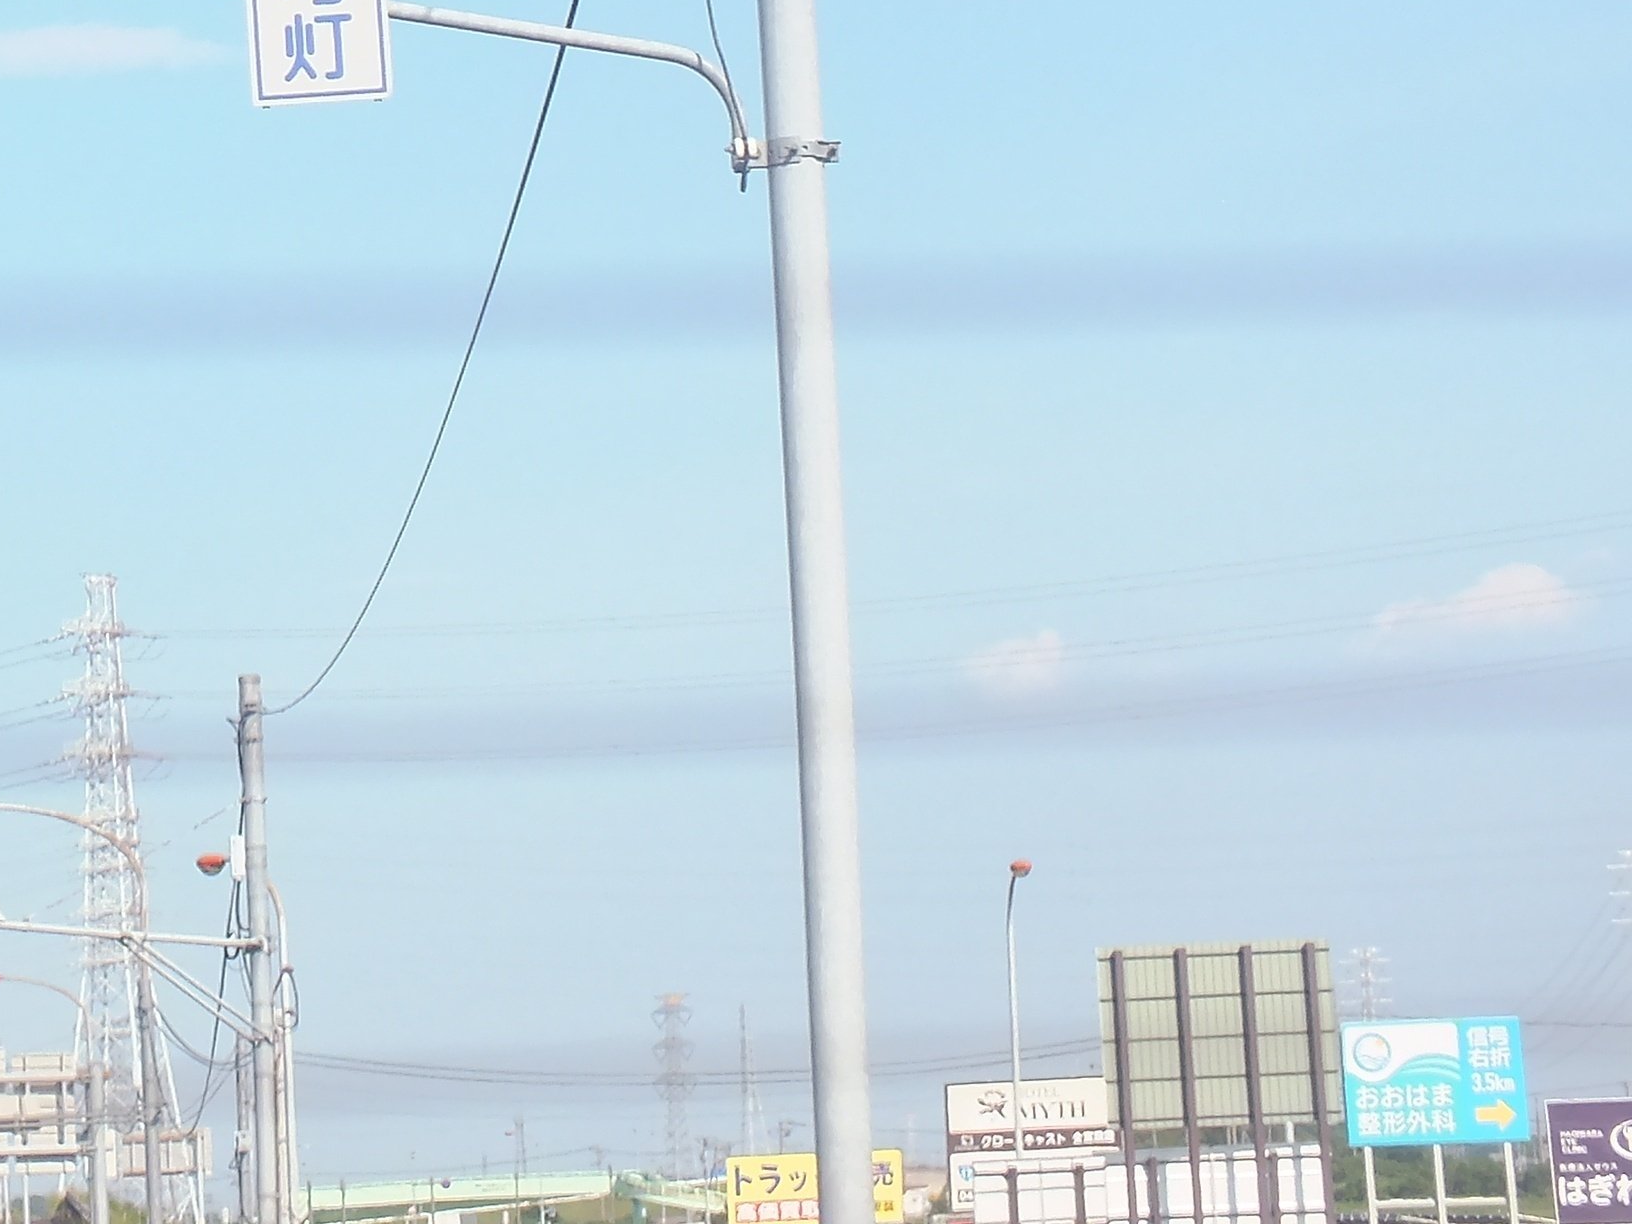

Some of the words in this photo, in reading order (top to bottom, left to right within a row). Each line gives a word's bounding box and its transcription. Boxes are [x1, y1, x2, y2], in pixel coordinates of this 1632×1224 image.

[1467, 1027, 1508, 1047] 信号
[1470, 1048, 1511, 1068] 右折
[1472, 1072, 1516, 1092] 3.5km
[1356, 1083, 1454, 1109] おおはま
[1358, 1108, 1456, 1136] 整形外科
